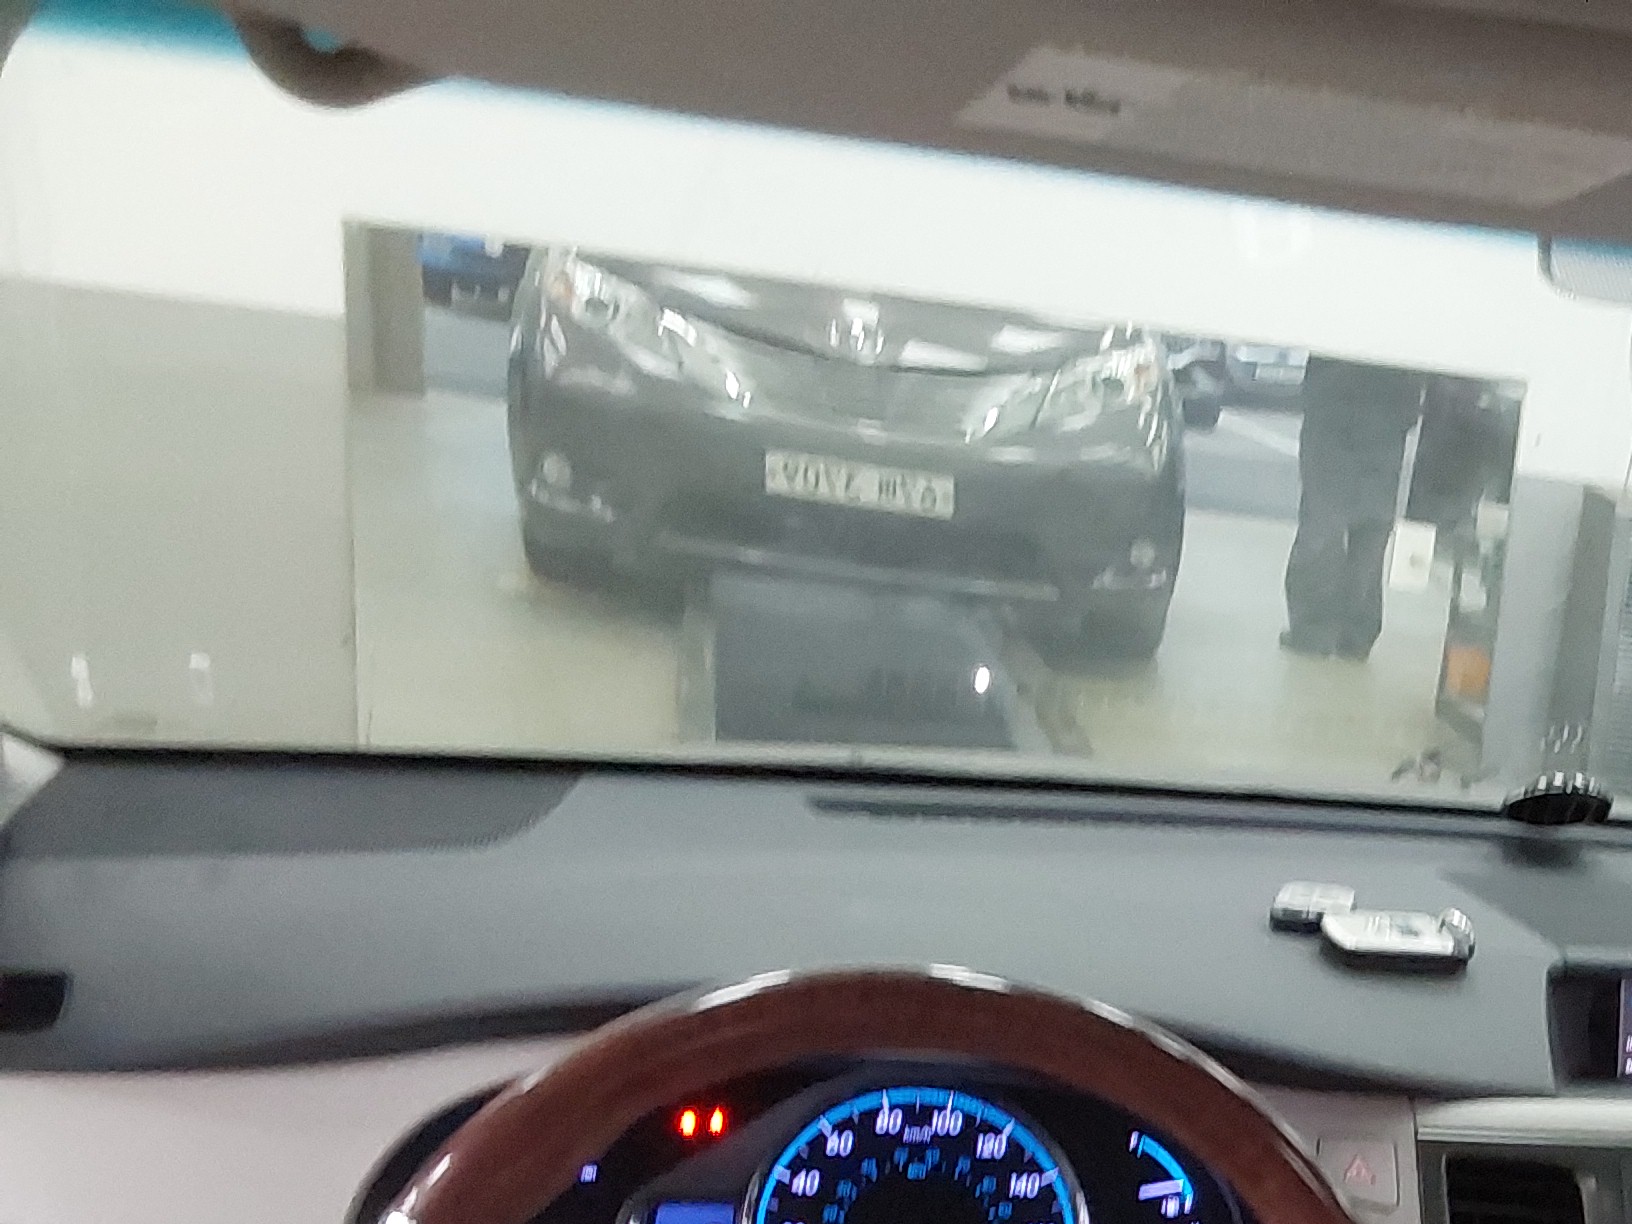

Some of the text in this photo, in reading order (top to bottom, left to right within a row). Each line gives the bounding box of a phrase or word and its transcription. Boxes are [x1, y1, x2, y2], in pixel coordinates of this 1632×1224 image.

[931, 1109, 963, 1136] 100
[975, 1132, 1007, 1159] 120
[791, 1169, 820, 1197] 40
[1008, 1172, 1040, 1199] 140
